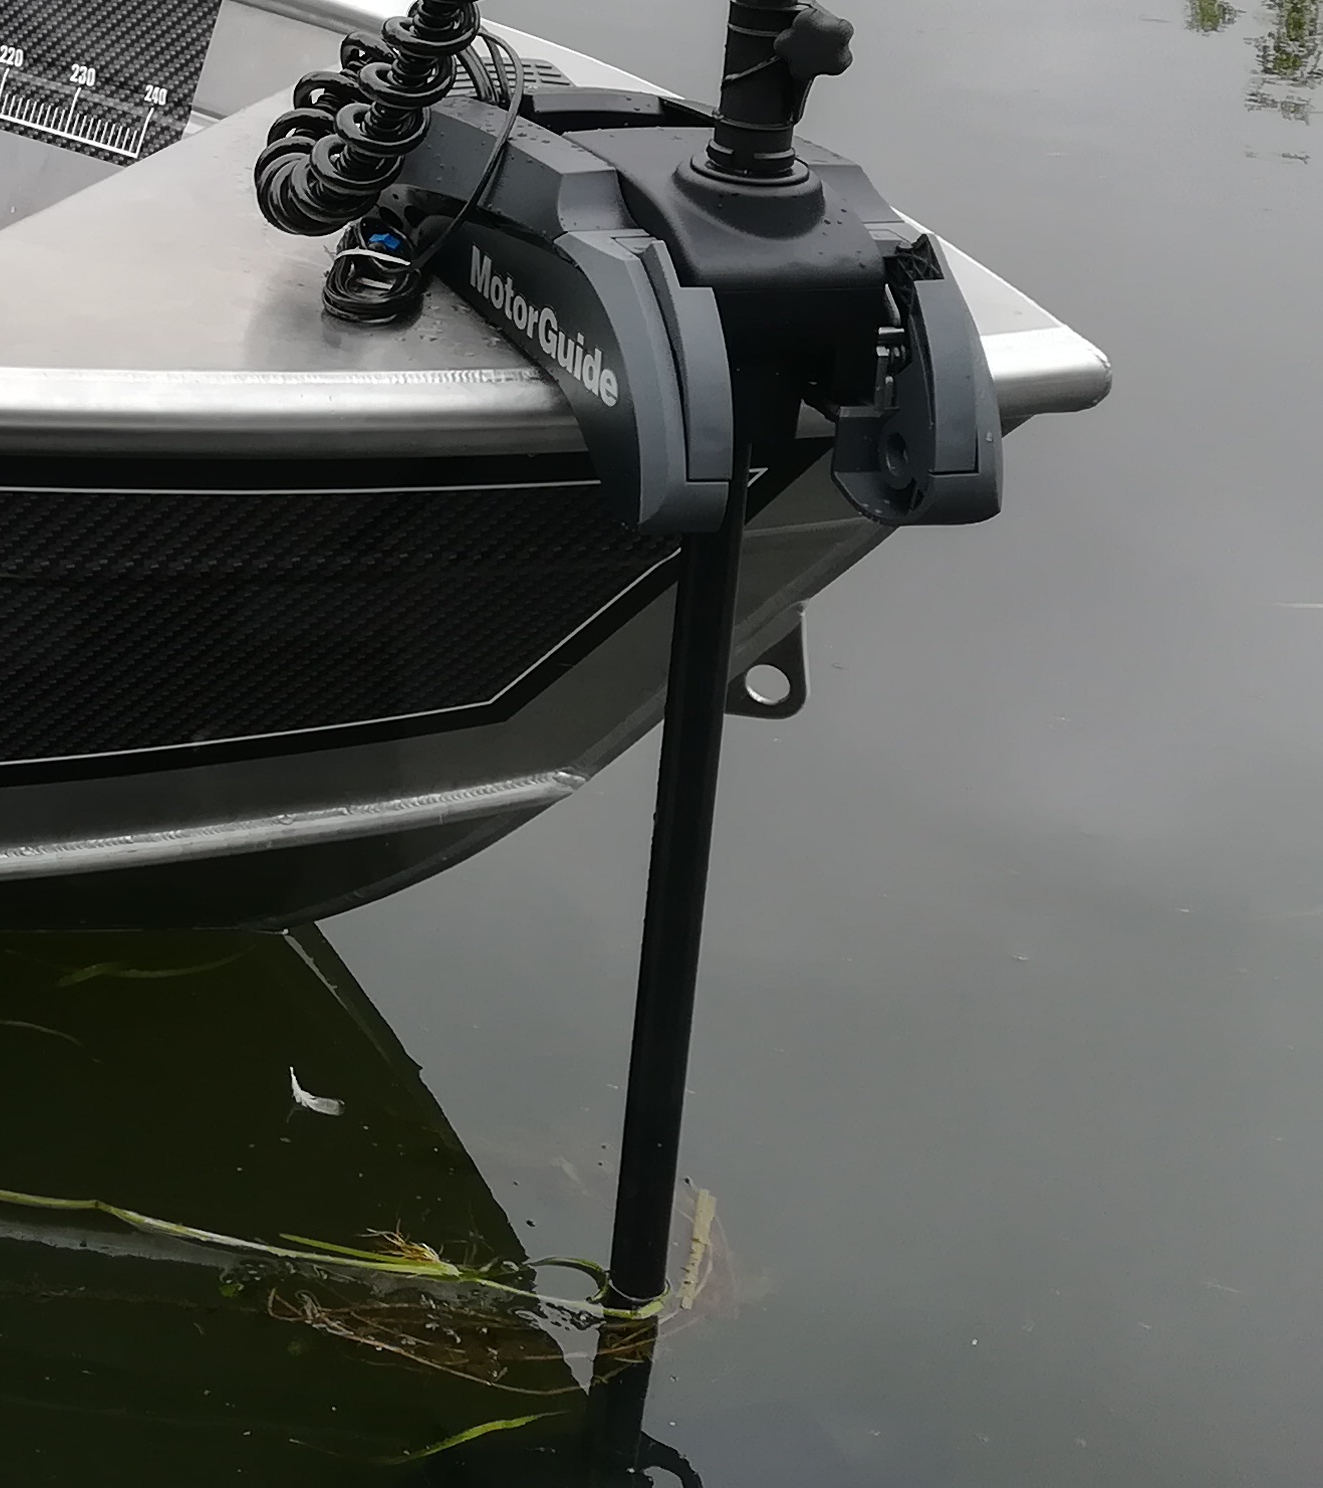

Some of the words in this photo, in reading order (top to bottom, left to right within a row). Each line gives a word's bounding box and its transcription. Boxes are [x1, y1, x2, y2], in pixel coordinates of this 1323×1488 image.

[70, 64, 96, 87] 230
[144, 84, 167, 106] 240
[468, 243, 619, 408] MotorGuide
